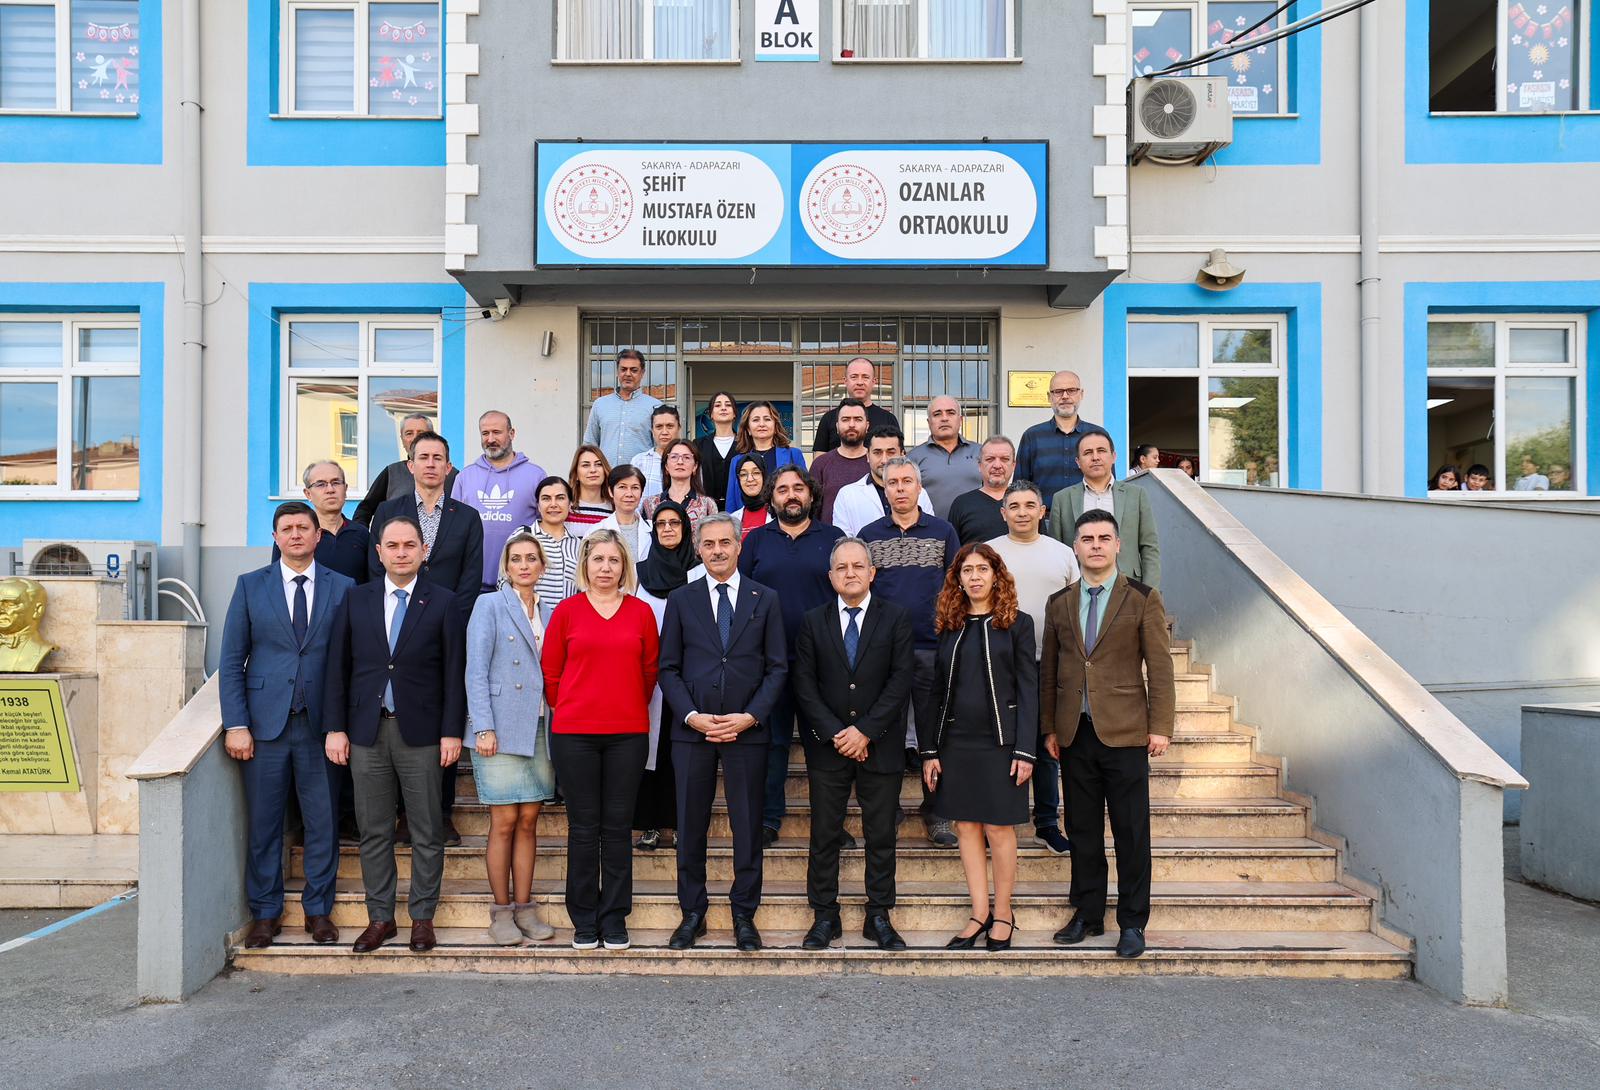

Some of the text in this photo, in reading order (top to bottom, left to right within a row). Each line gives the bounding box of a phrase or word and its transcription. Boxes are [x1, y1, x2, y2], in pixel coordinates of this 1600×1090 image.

[774, 0, 800, 25] A
[760, 31, 813, 48] BLOK
[641, 161, 682, 170] SAKARYA
[689, 161, 741, 170] ADAPAZARI
[899, 163, 943, 173] SAKARYA
[950, 163, 1005, 173] ADAPAZARI
[642, 172, 687, 196] ŞEHİT
[899, 182, 986, 202] OZANLAR
[642, 199, 756, 219] MUSTAFA ÖZEN
[899, 214, 1009, 235] ORTAOKULU
[642, 226, 717, 246] İLKOKULU
[0, 697, 29, 707] 1938
[22, 767, 52, 775] ATATÜRK
